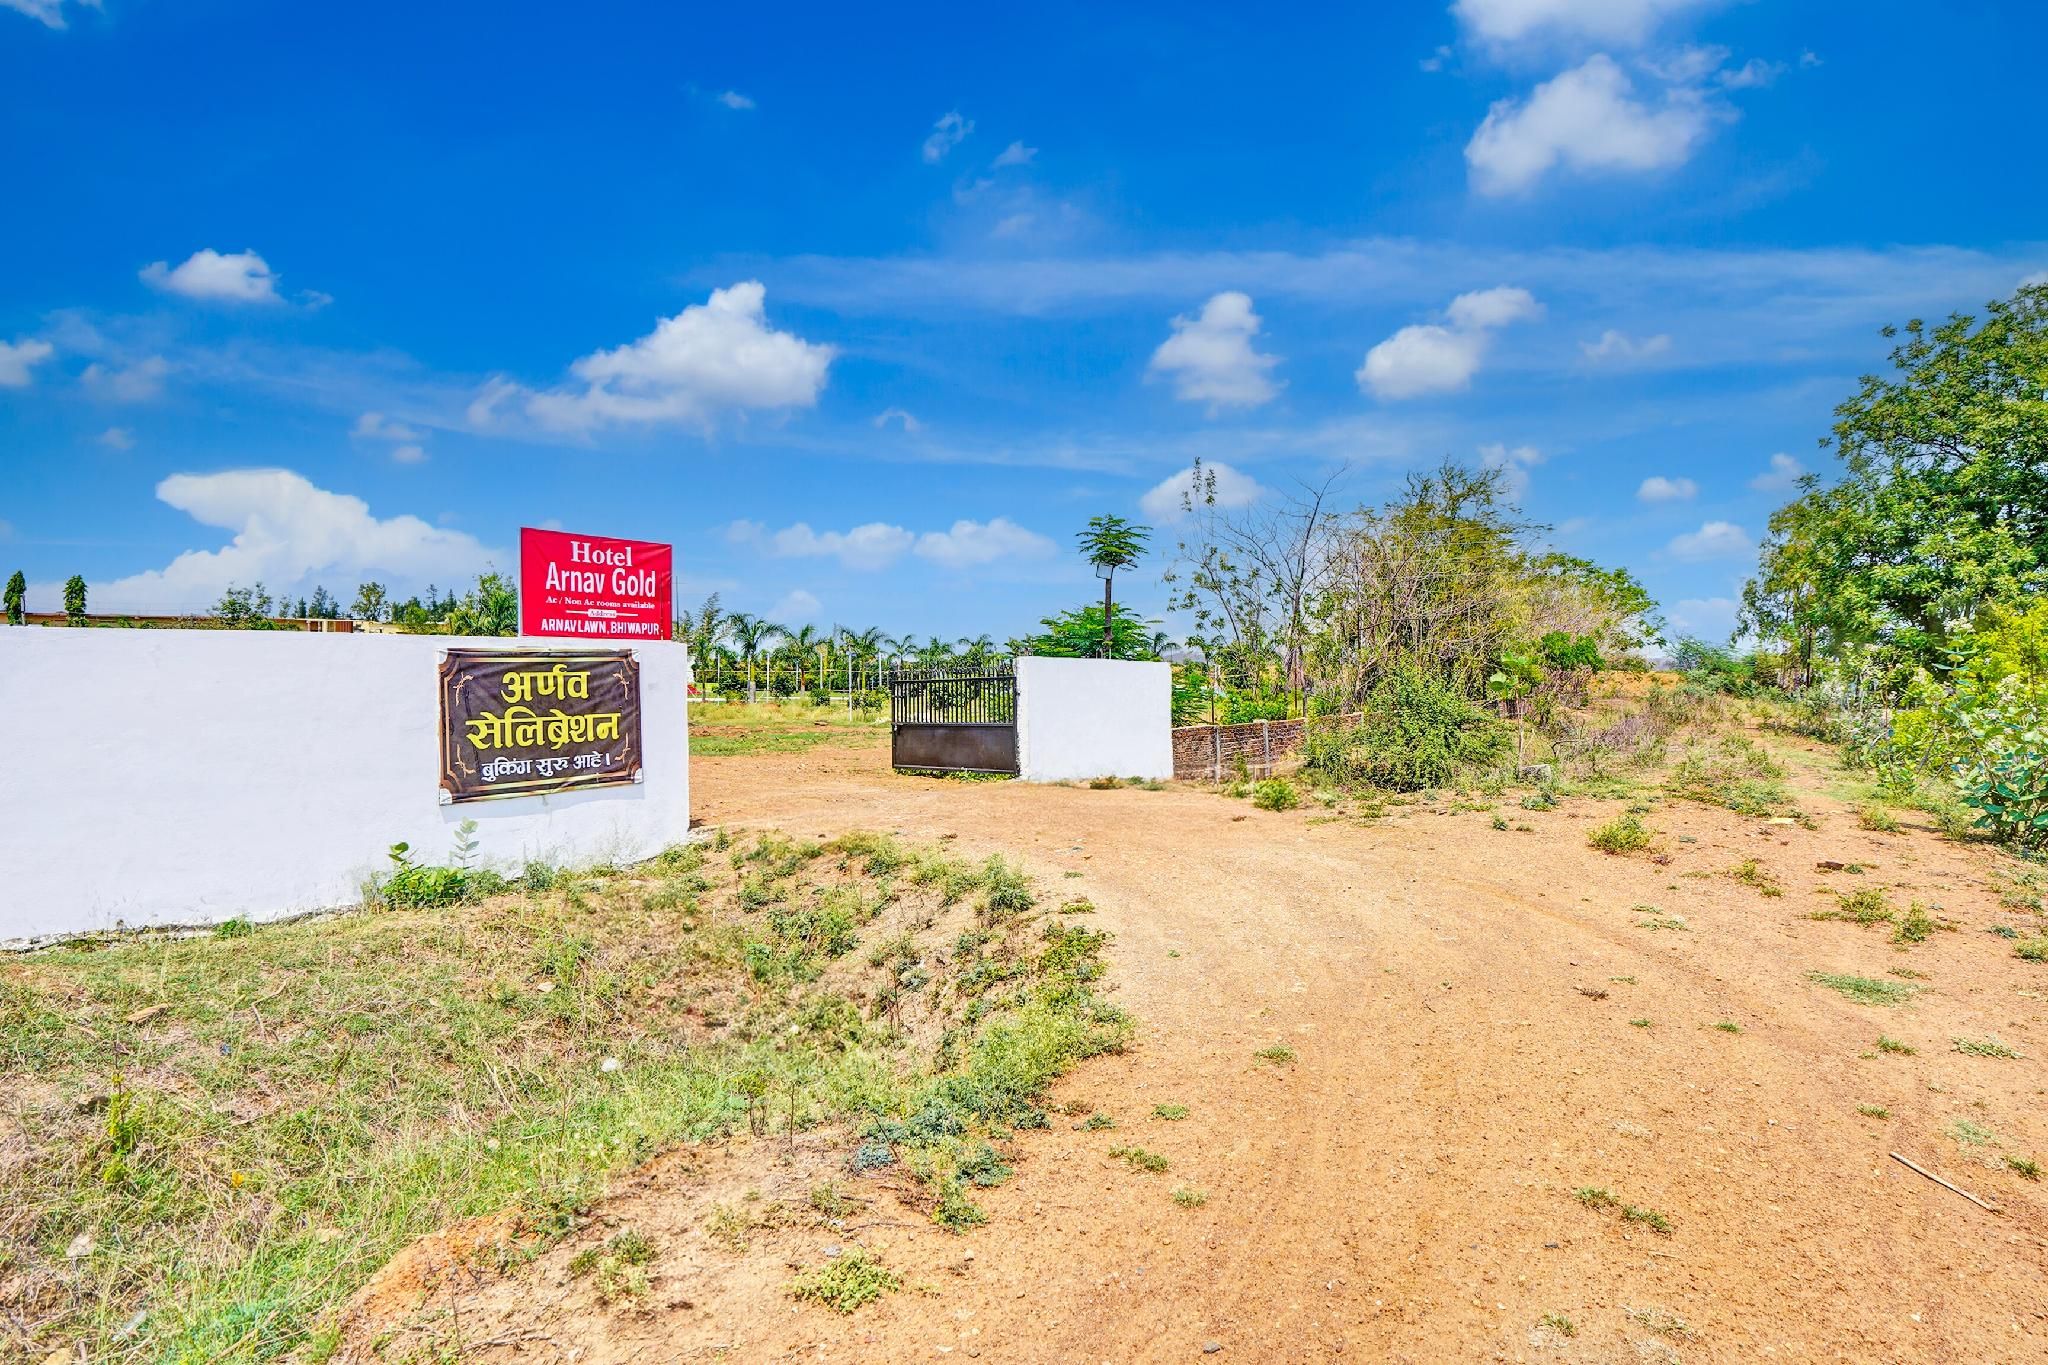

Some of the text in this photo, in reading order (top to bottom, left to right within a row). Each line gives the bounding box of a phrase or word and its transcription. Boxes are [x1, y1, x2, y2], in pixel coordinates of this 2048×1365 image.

[570, 541, 632, 567] Hotel
[545, 561, 656, 597] Arnav Gold
[622, 601, 655, 609] available
[541, 619, 576, 632] ARNAV
[611, 622, 659, 635] BHIWAPUR
[500, 664, 590, 703] अर्णव
[465, 706, 621, 750] सेलिब्रेशन
[481, 758, 533, 781] बुकिंग
